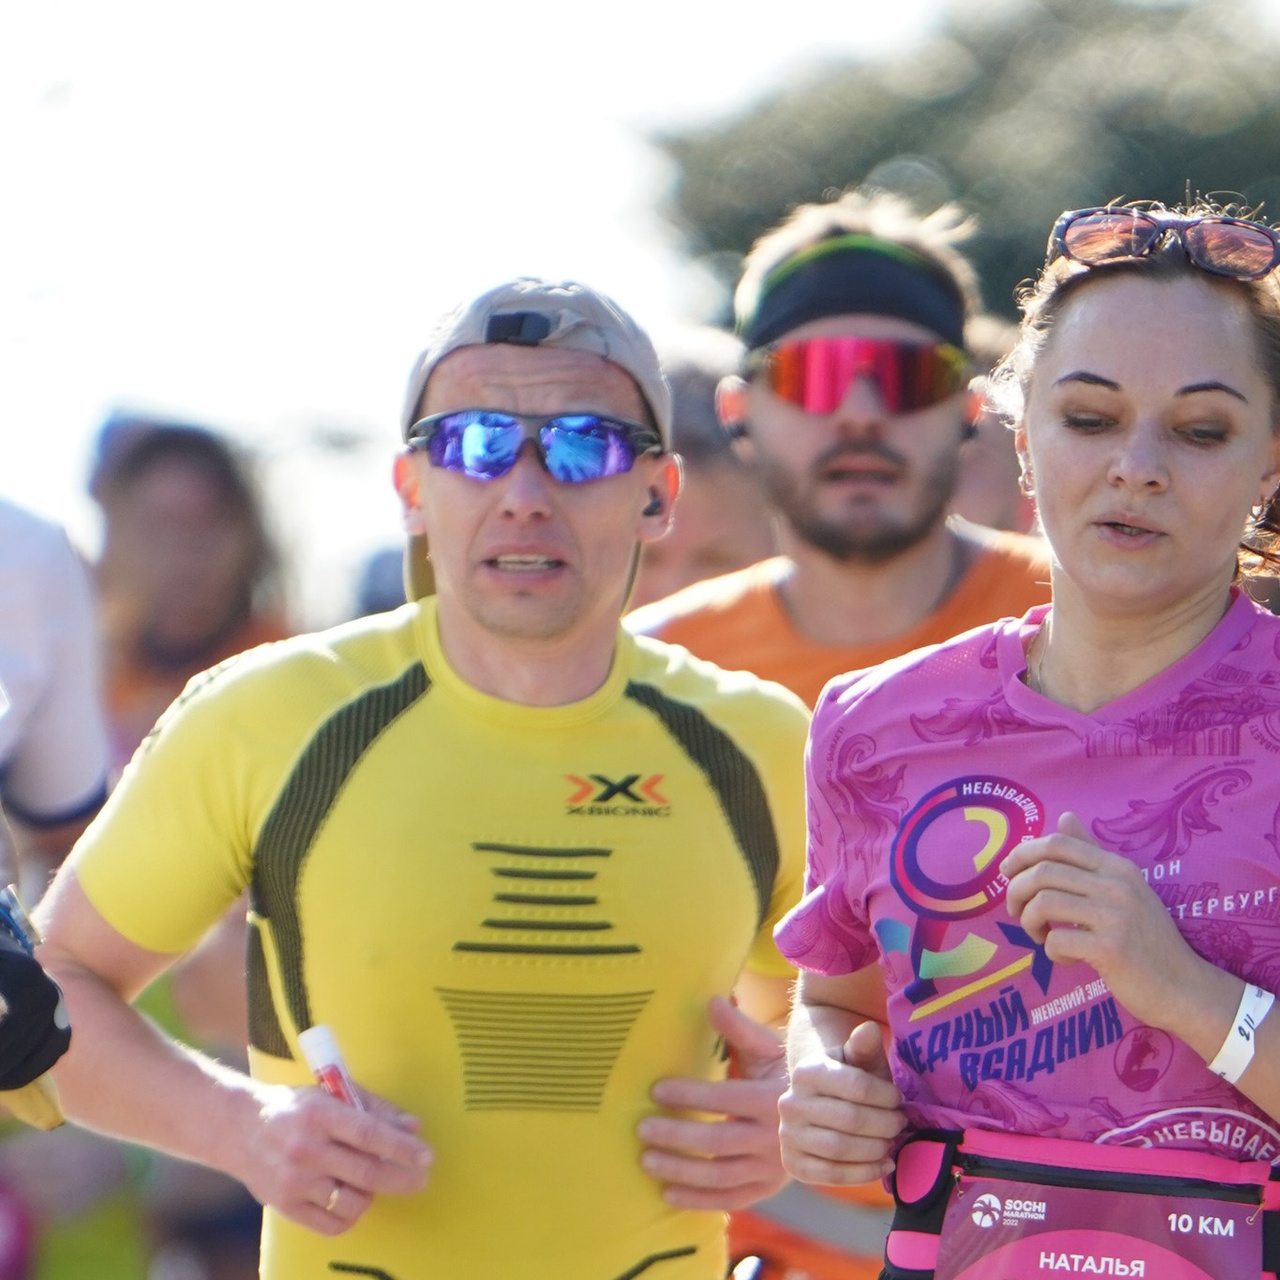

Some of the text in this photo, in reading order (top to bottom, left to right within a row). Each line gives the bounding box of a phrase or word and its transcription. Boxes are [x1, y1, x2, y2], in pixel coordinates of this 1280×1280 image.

[962, 781, 1039, 824] НЕБЫВАЕМОЕ
[1166, 886, 1279, 919] ТЕРБУРГ
[959, 996, 1124, 1092] ВСАДНИК
[1003, 1210, 1045, 1221] MARATHON
[1004, 1199, 1046, 1213] SOCHI
[1002, 1218, 1018, 1226] 2022
[1168, 1213, 1193, 1232] 10
[1039, 1252, 1146, 1277] НАТАЛЬЯ
